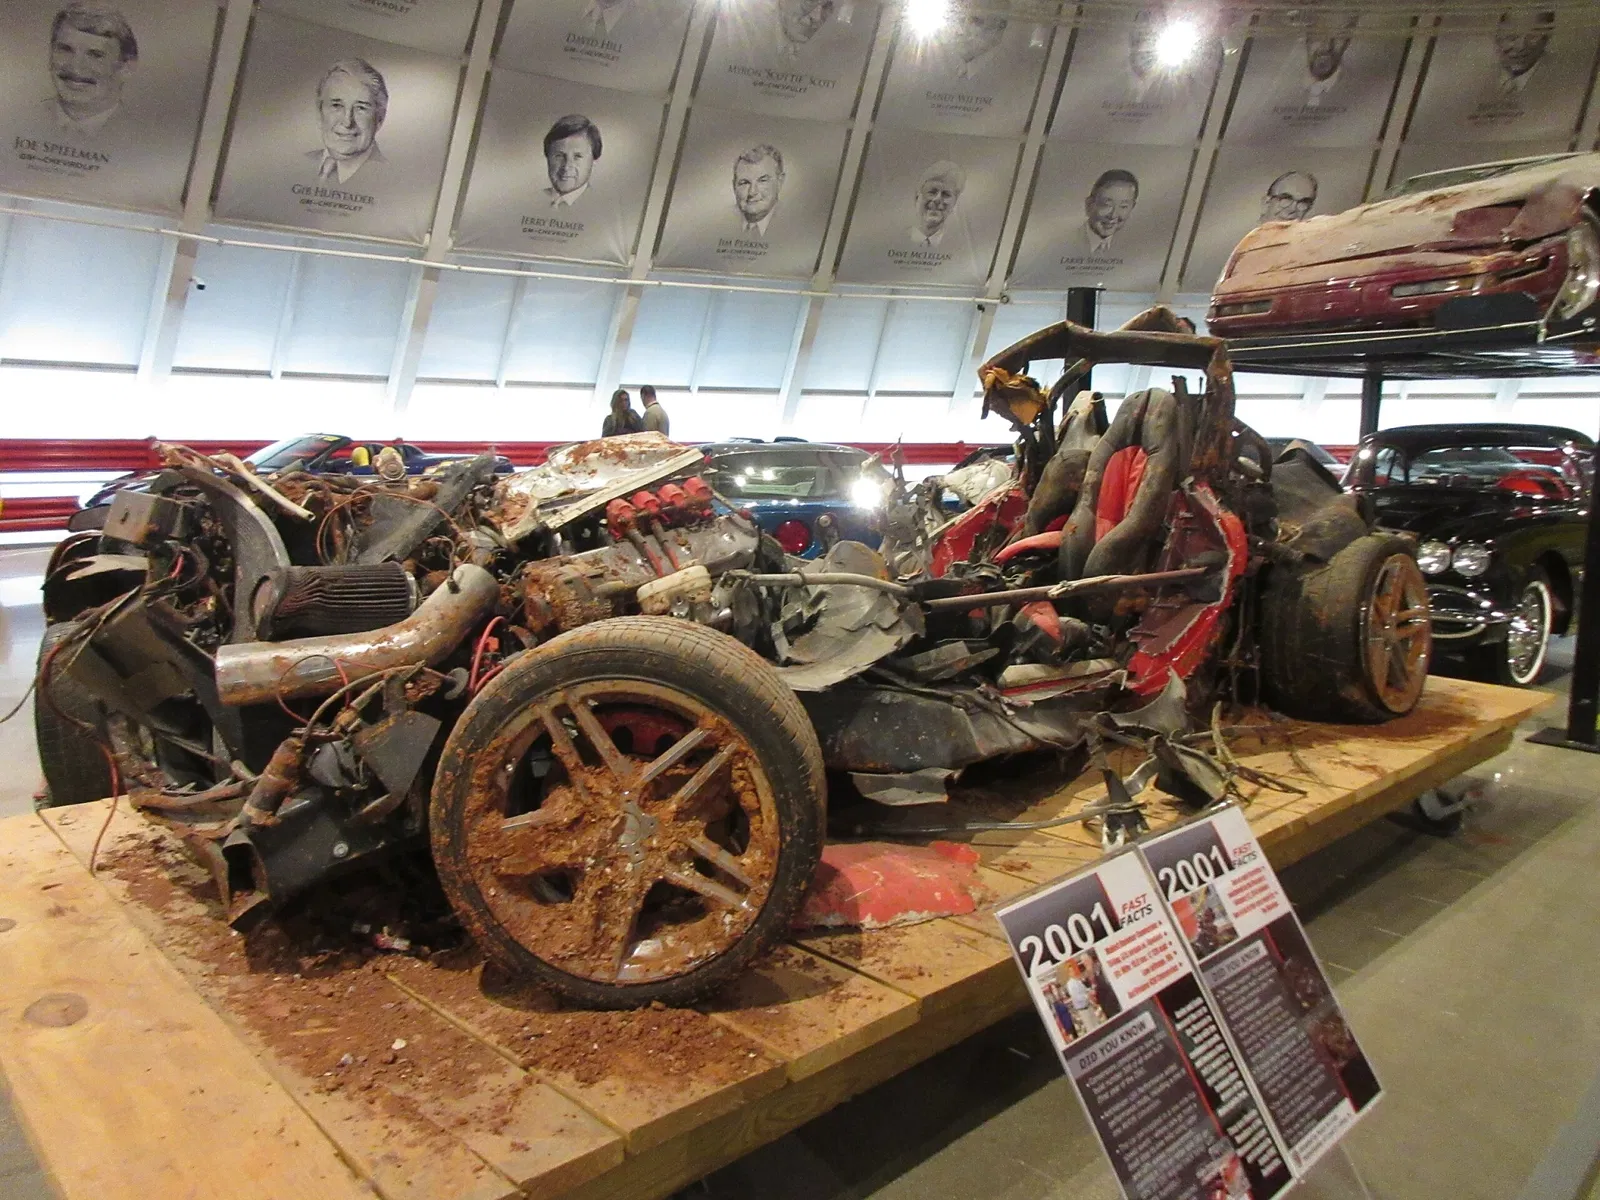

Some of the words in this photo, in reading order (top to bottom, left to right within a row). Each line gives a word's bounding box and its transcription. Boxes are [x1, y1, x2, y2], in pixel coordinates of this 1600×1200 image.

[14, 135, 37, 151] JOE
[521, 215, 546, 227] JERRY
[549, 218, 585, 232] PALMER
[1233, 842, 1252, 857] FAST
[1233, 850, 1258, 868] FACTS
[1158, 845, 1230, 901] 2001
[1121, 893, 1148, 914] FAST
[1120, 904, 1153, 928] FACTS
[1019, 901, 1116, 978] 2001
[1079, 1051, 1098, 1069] DID
[1099, 1039, 1119, 1057] YOU
[1119, 1021, 1146, 1044] KNOW
